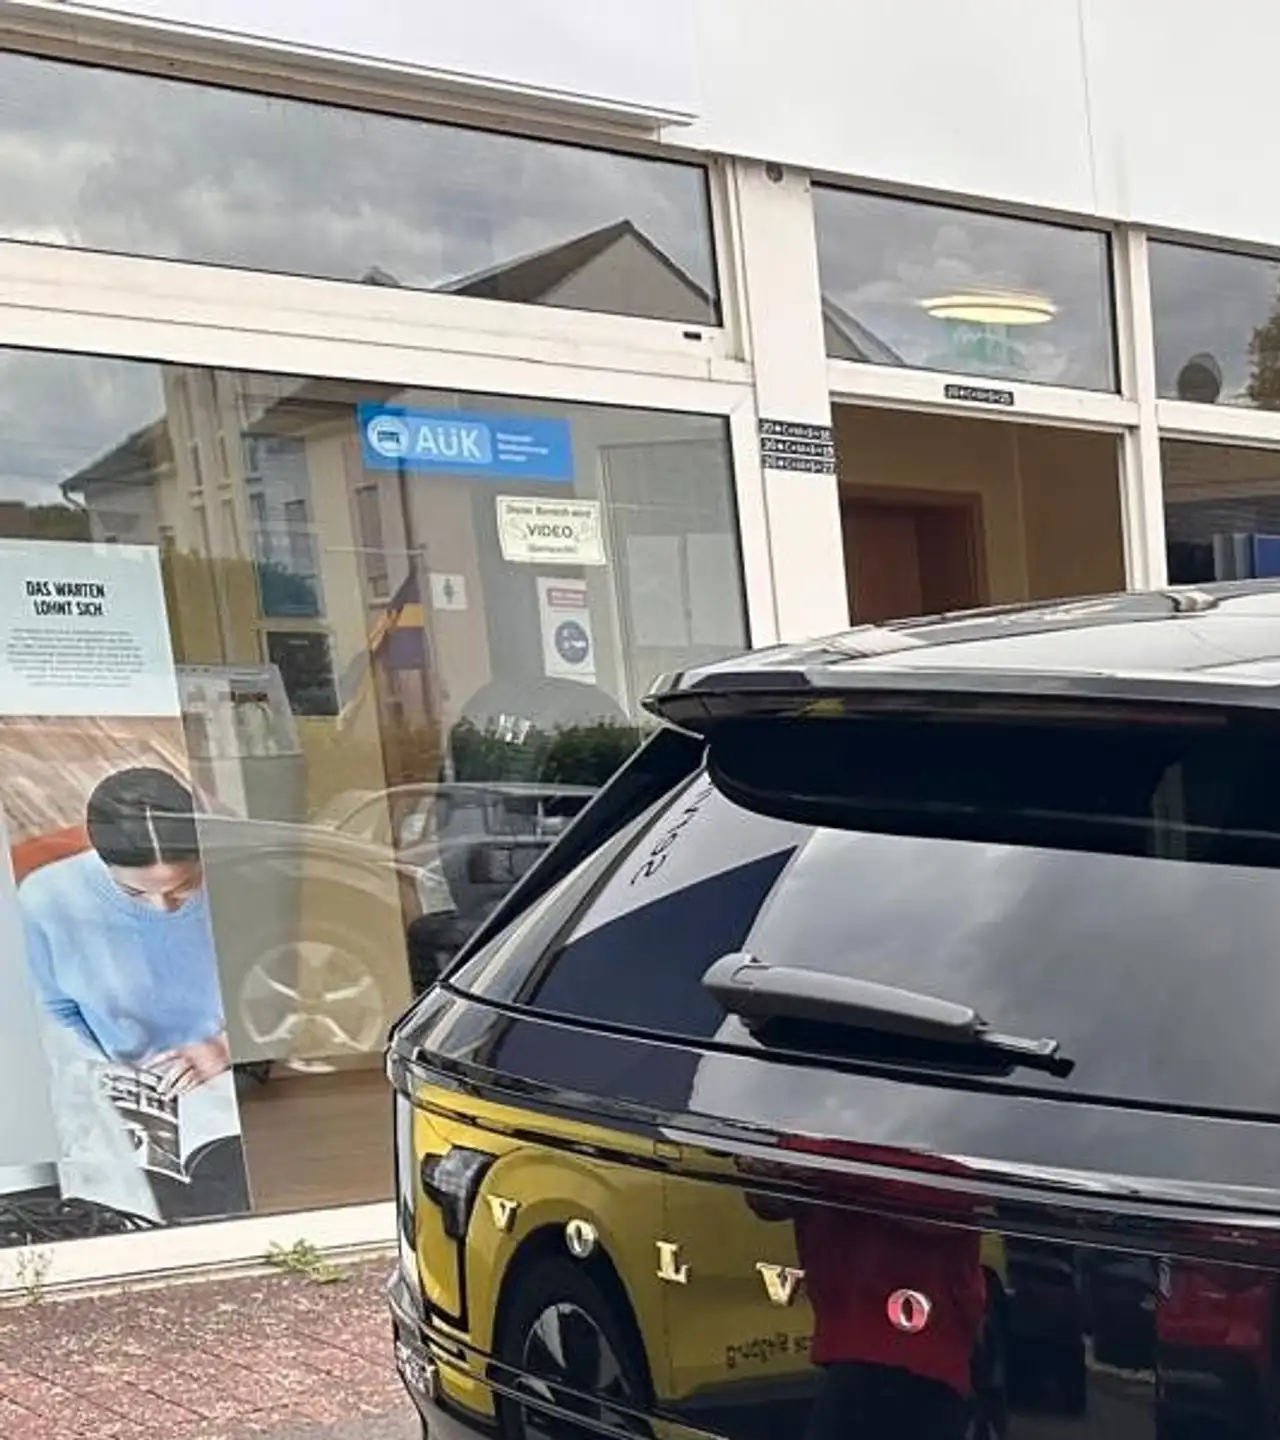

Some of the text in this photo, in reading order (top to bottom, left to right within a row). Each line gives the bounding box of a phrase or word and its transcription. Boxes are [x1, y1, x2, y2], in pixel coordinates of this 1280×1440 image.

[526, 523, 573, 539] VIDEO
[26, 581, 105, 598] DAS WARTEN
[33, 600, 103, 616] LOHNT SICH
[487, 1195, 931, 1333] VOLVO
